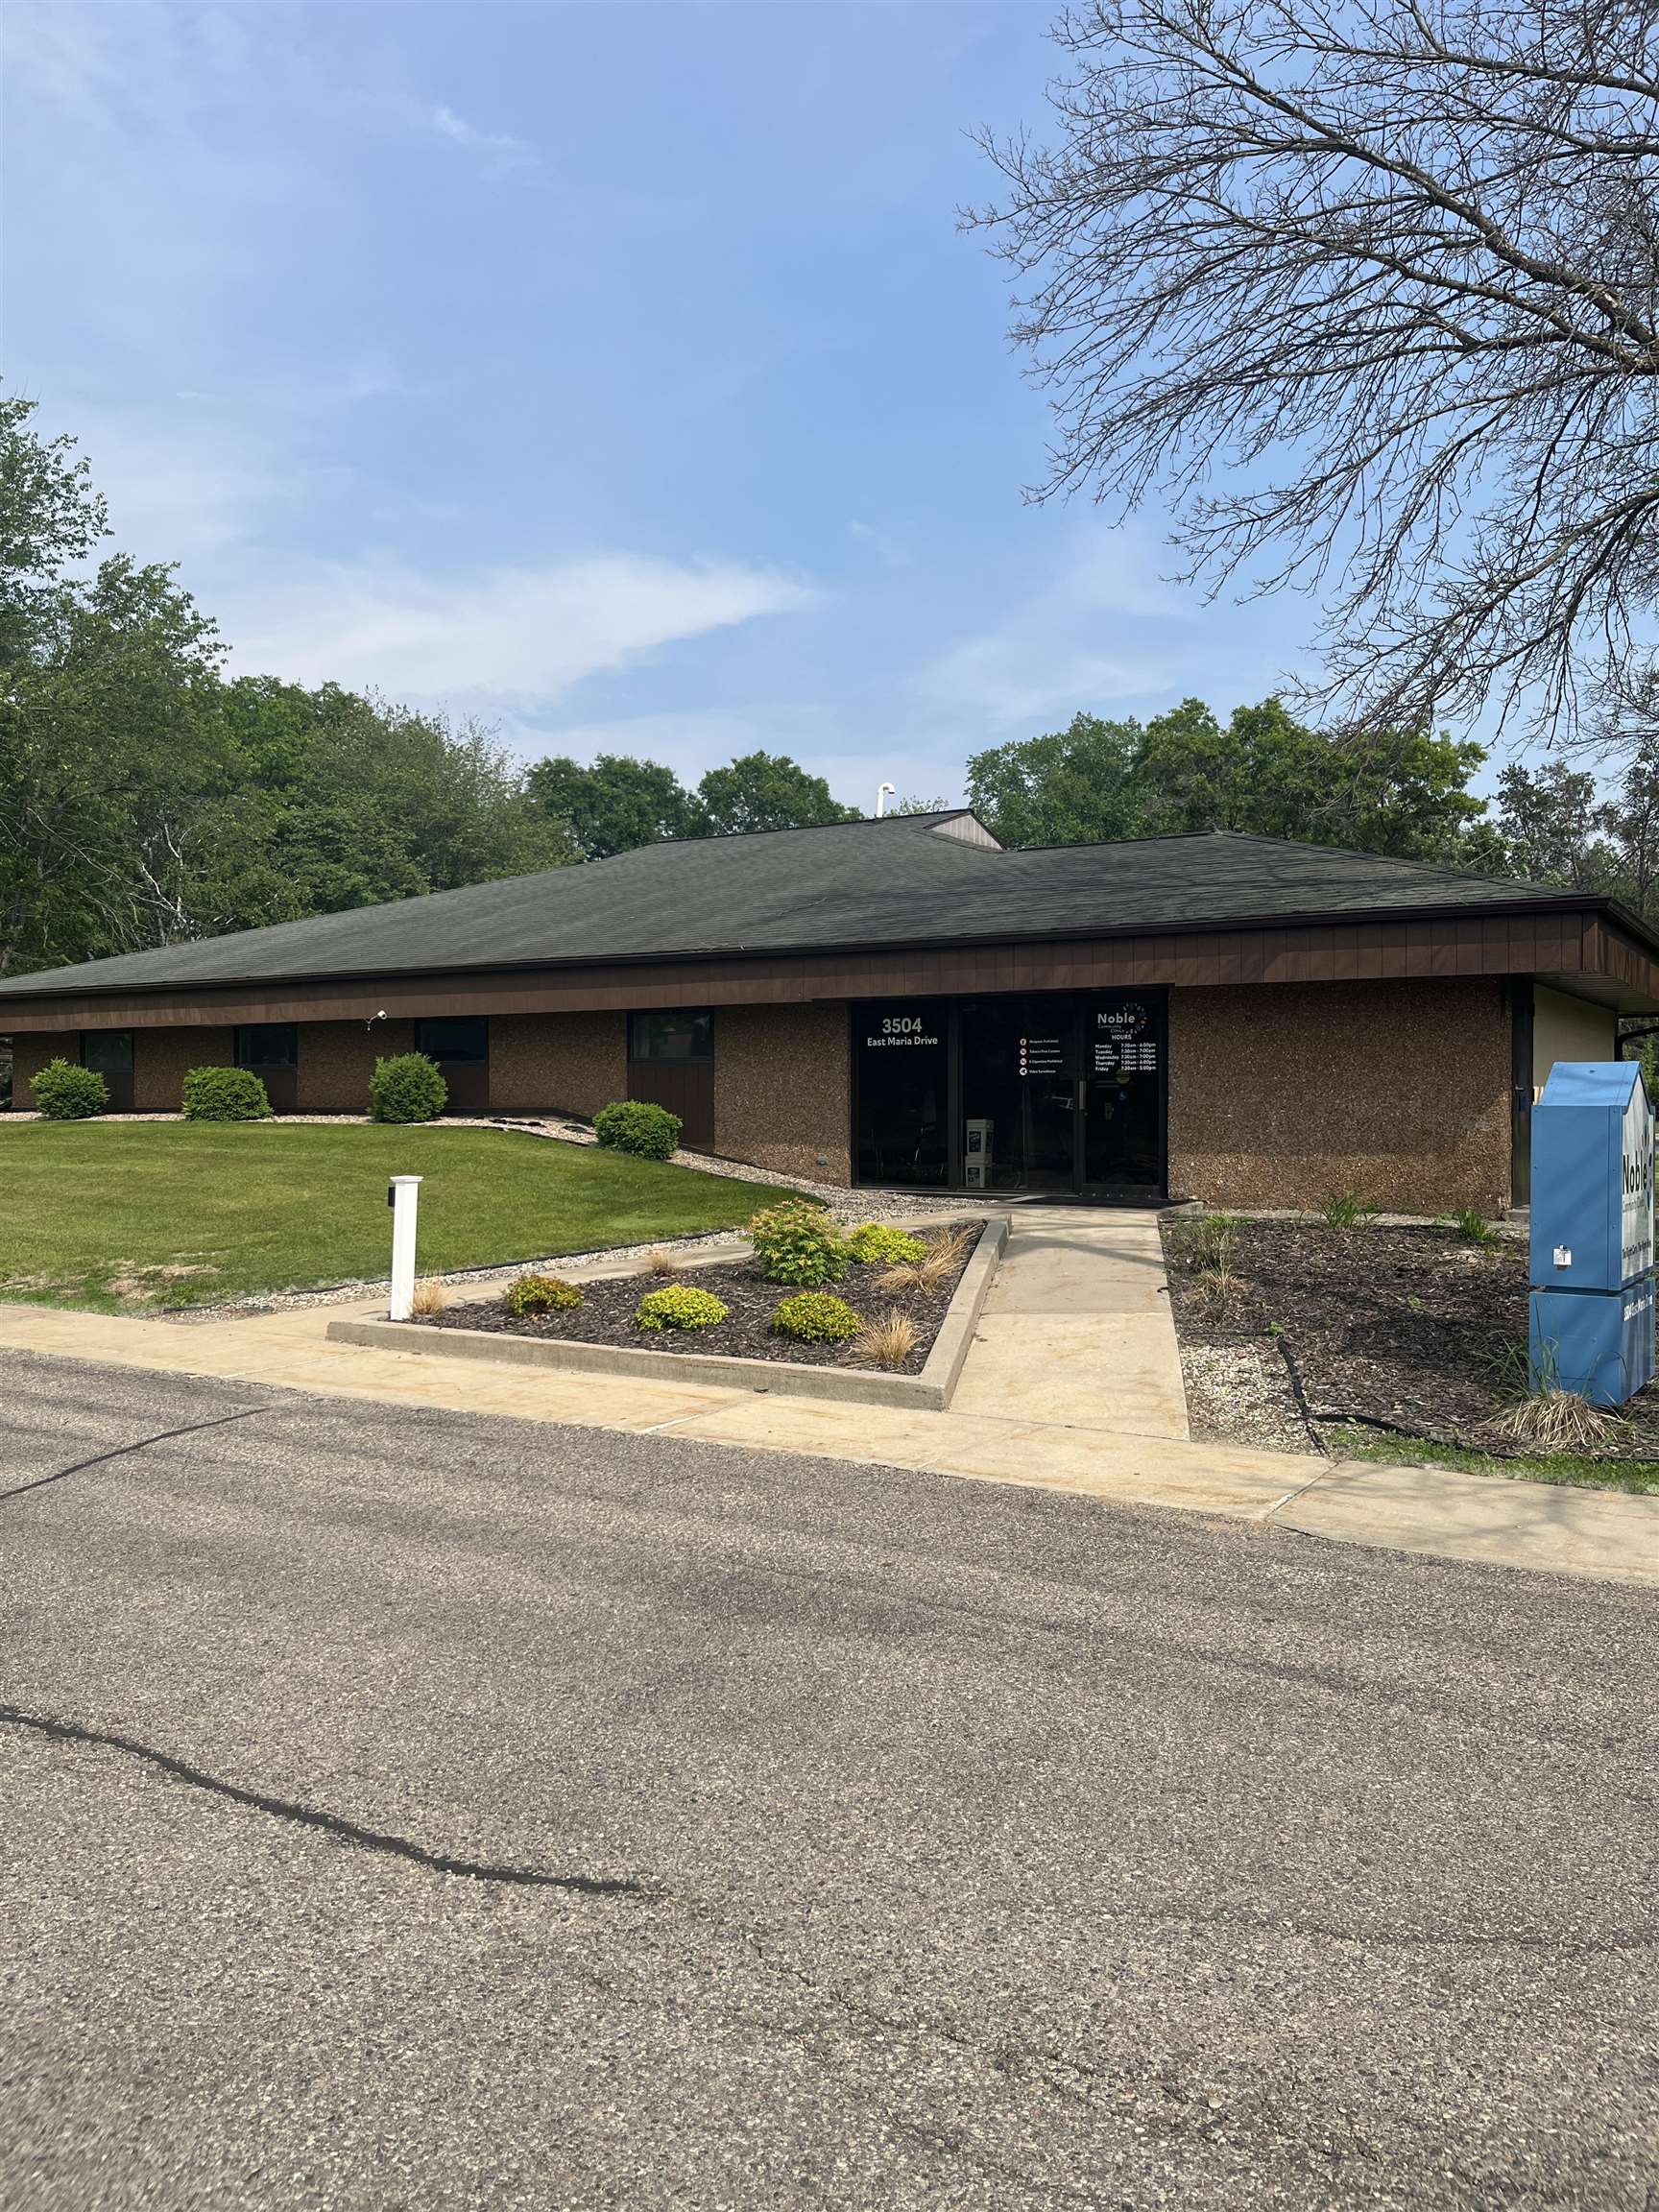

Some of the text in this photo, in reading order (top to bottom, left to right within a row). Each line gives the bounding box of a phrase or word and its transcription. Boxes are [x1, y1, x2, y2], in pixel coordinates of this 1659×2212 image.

[1097, 1013, 1135, 1023] Noble
[882, 1018, 923, 1033] 3504
[867, 1036, 938, 1046] East Maria Drive
[1623, 1150, 1647, 1193] Noble
